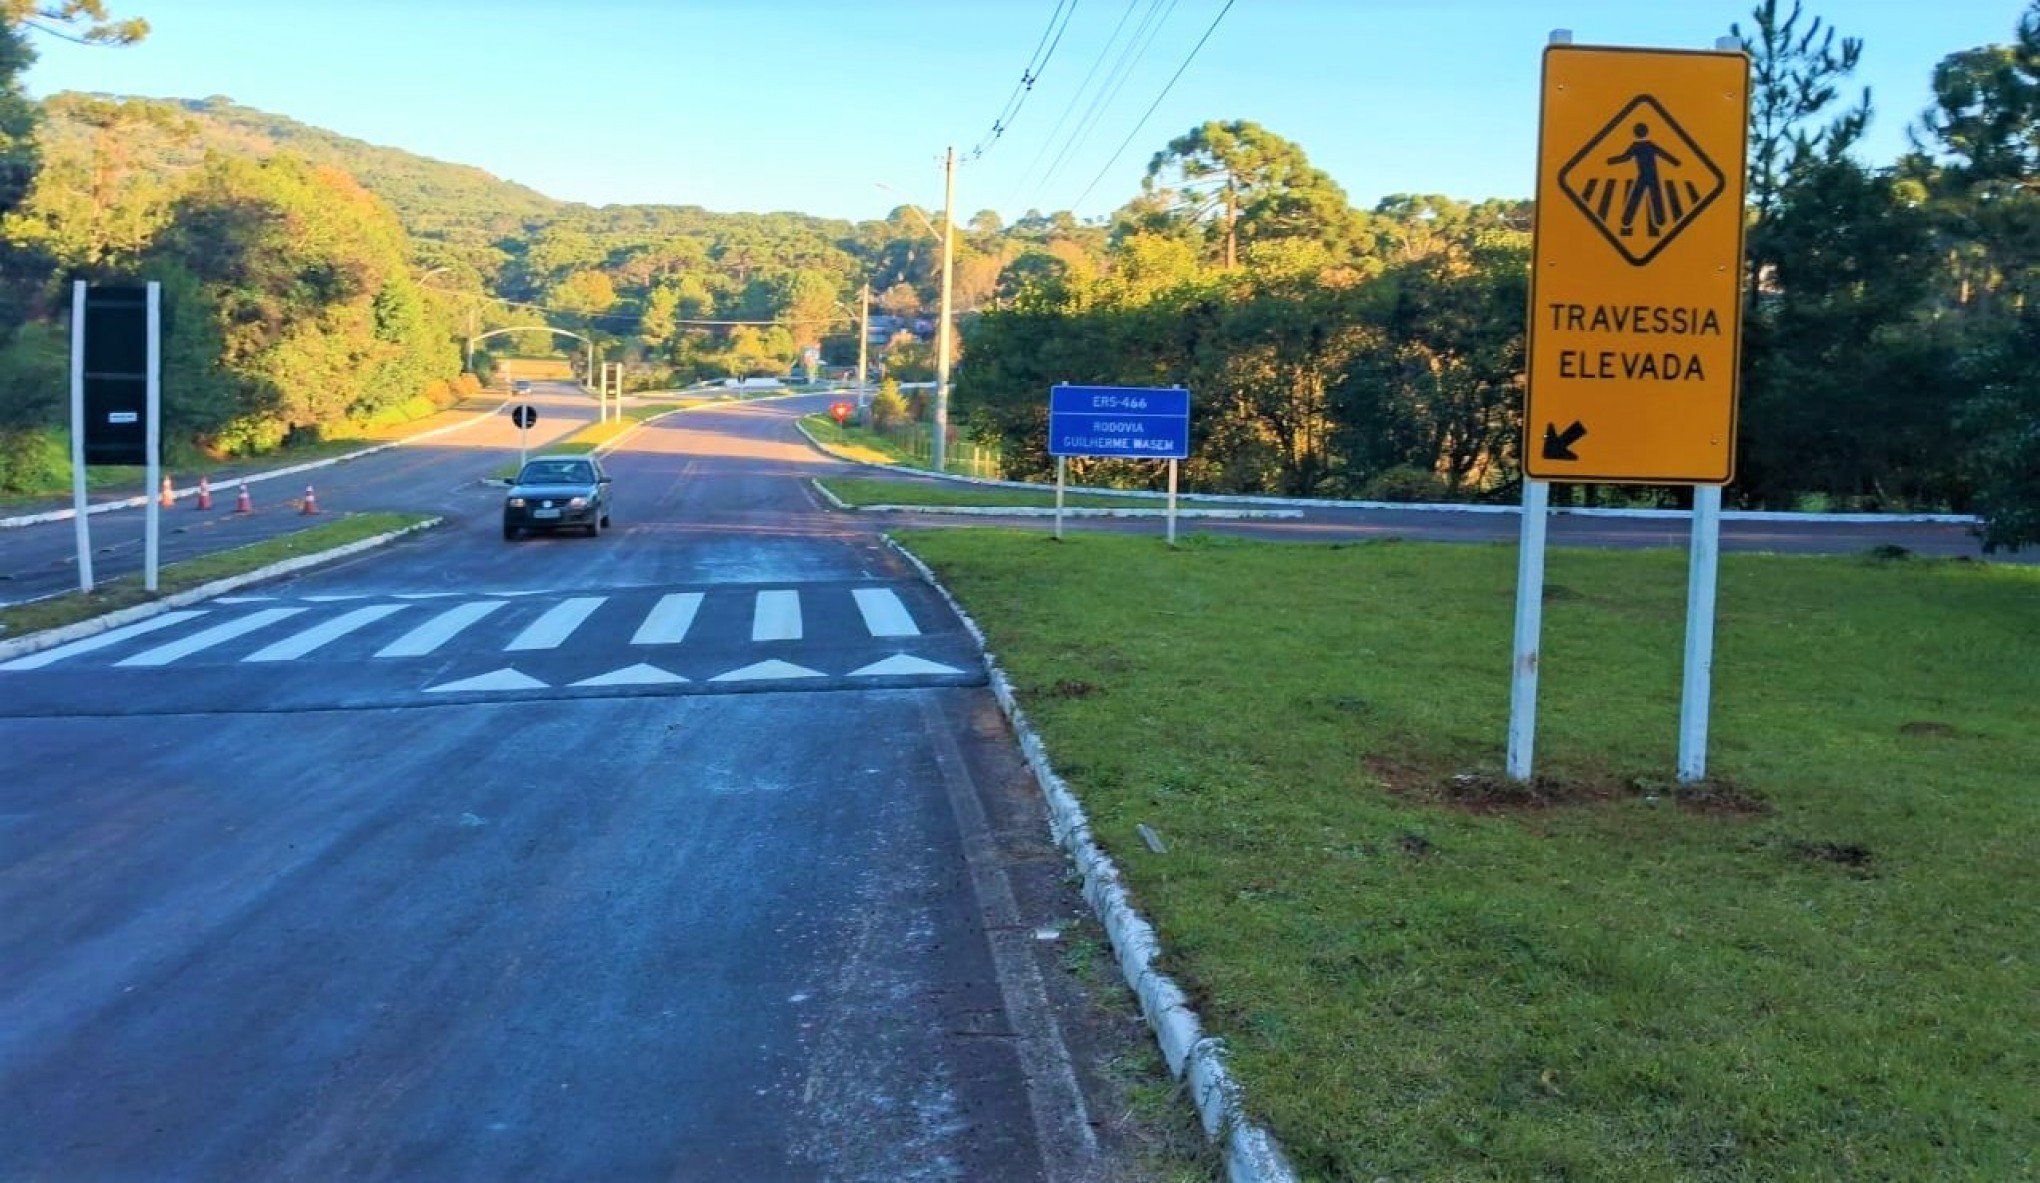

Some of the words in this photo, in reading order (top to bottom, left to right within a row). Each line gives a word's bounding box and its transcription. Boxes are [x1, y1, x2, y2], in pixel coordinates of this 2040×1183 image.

[1549, 304, 1721, 335] TRAVESSIA
[1559, 350, 1705, 381] ELEVADA
[1092, 396, 1148, 408] ERS-466
[1093, 422, 1144, 433] RODOVIA
[1063, 437, 1130, 449] GUILHERME
